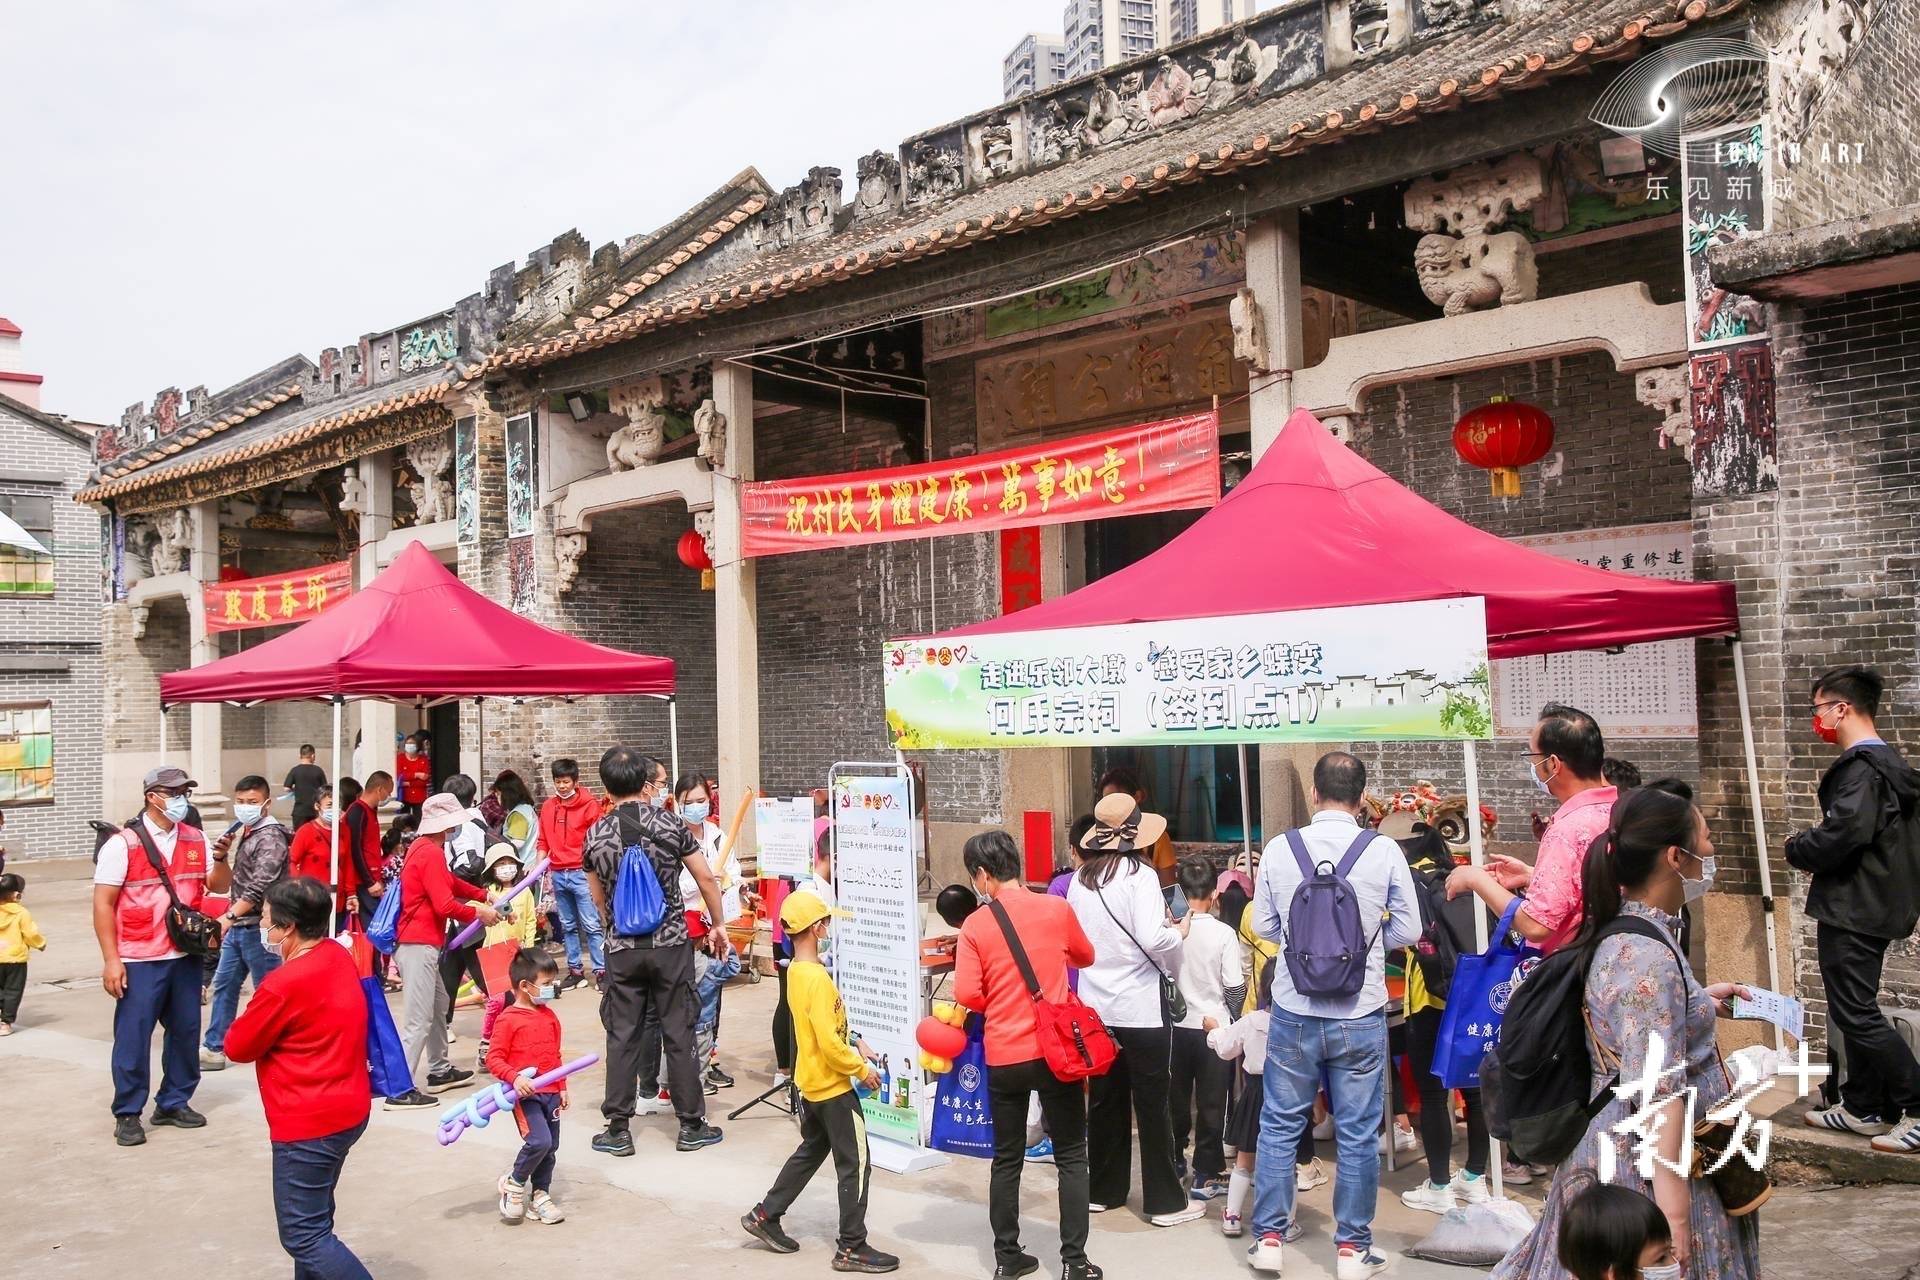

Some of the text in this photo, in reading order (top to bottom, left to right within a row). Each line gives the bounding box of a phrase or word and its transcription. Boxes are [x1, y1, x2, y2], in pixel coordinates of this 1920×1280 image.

[941, 1095, 983, 1110] 健康人生
[953, 1112, 993, 1125] 绿色无
